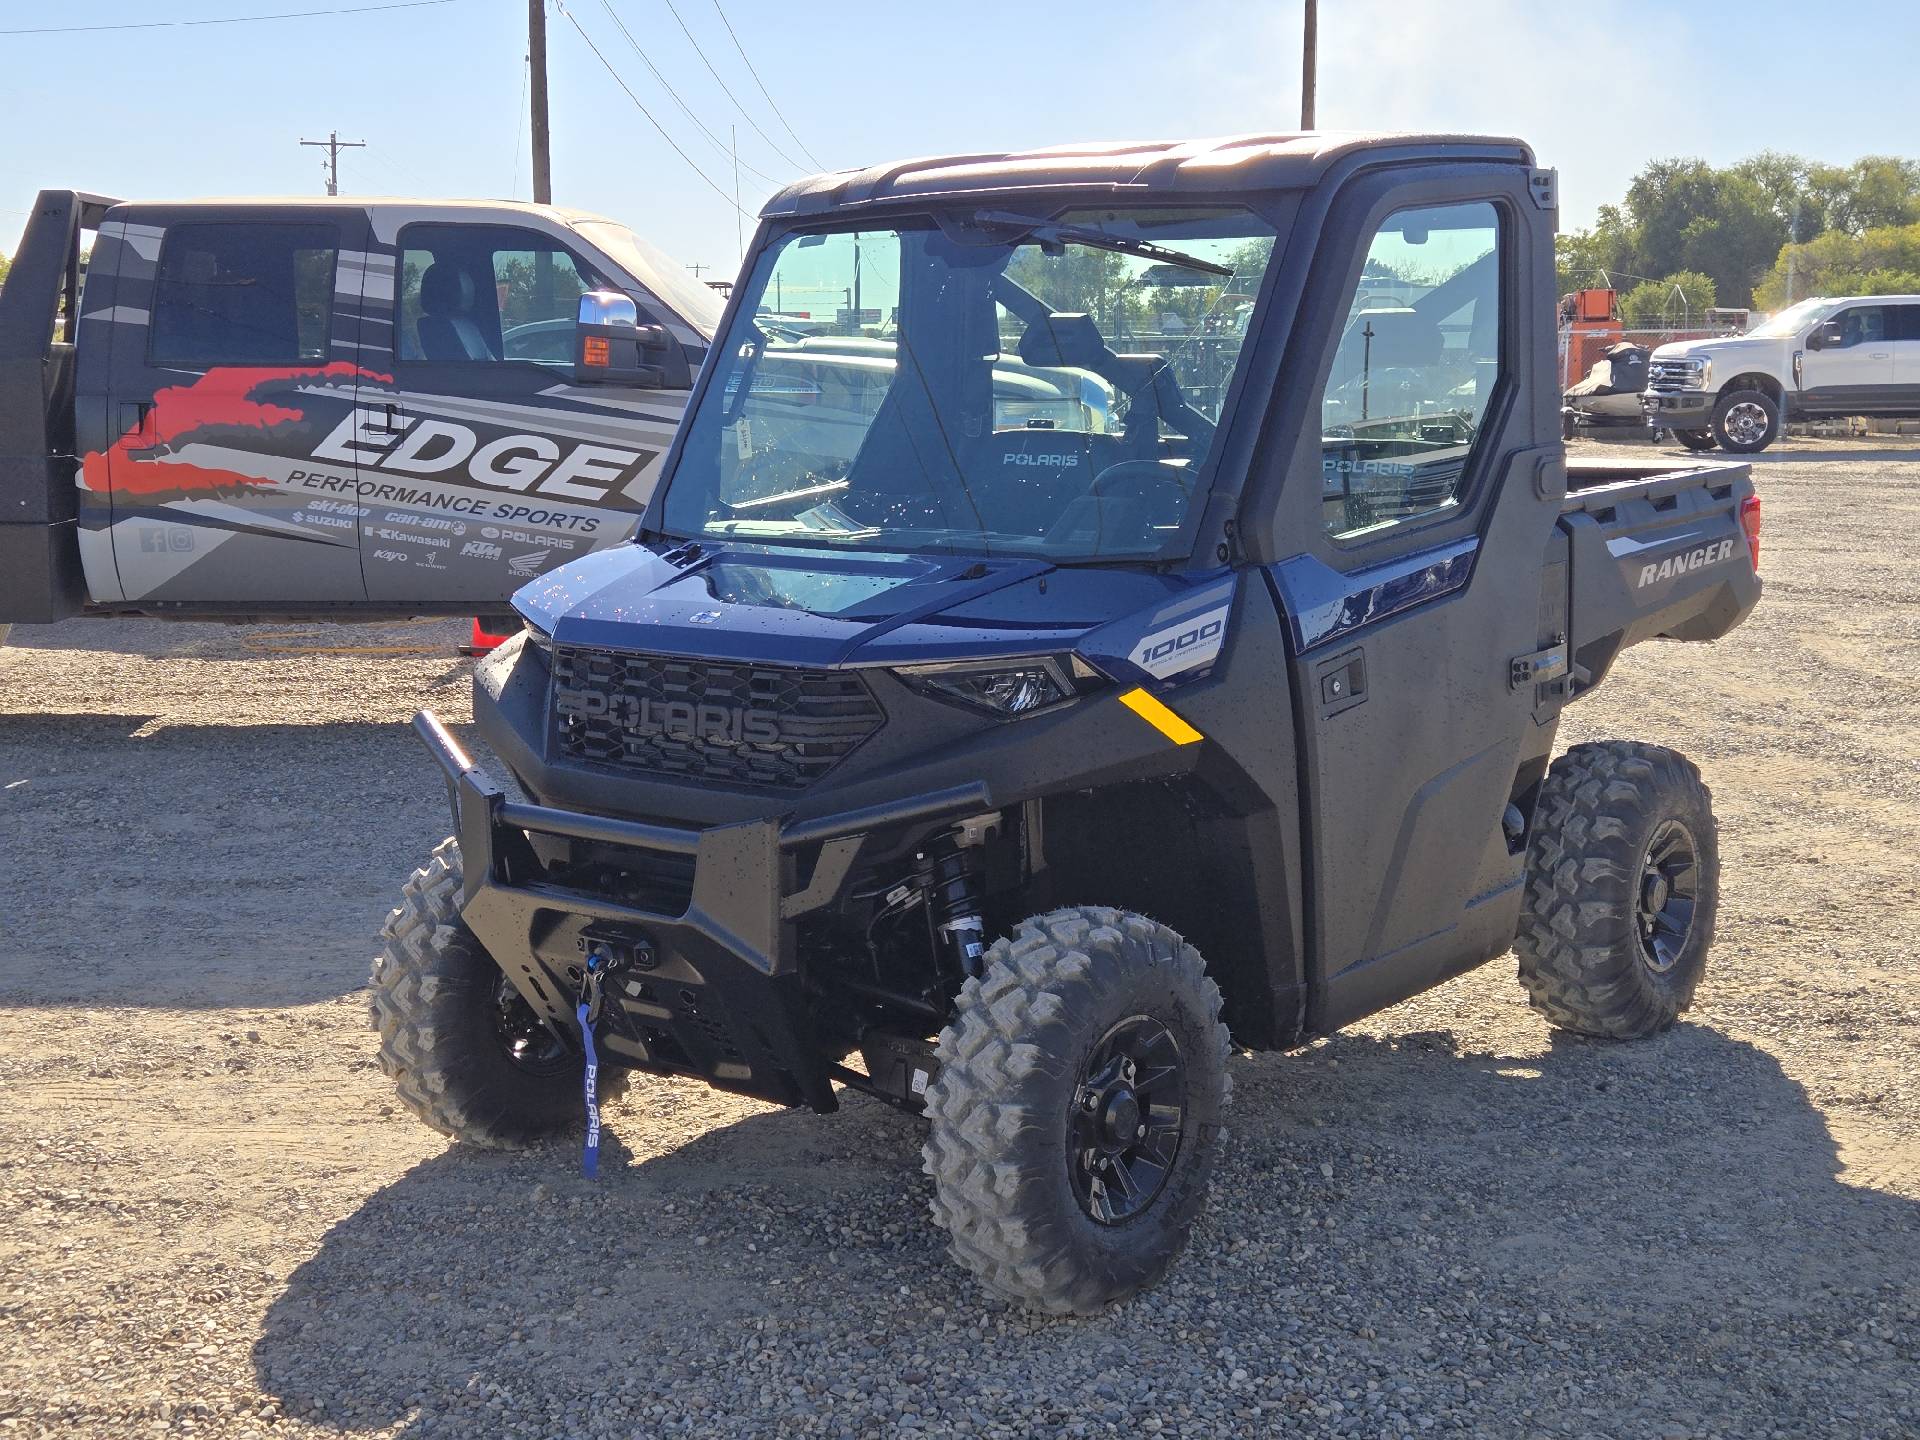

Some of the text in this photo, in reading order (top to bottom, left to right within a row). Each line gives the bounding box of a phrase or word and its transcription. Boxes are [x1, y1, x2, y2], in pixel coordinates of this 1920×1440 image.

[311, 408, 642, 501] EDGE
[1003, 453, 1079, 467] POLARIS
[1323, 459, 1416, 478] POLARIS
[286, 470, 601, 533] PERFORMANCE SPORTS
[306, 514, 353, 529] SUZUKI
[391, 530, 450, 548] Kawasaki
[501, 529, 575, 550] POLARIS
[462, 541, 502, 560] KTM
[508, 569, 542, 578] HOND
[1638, 540, 1733, 588] RANGER
[1143, 620, 1221, 665] 1000
[580, 689, 781, 744] POLARIS
[586, 1064, 600, 1148] POLARIS
